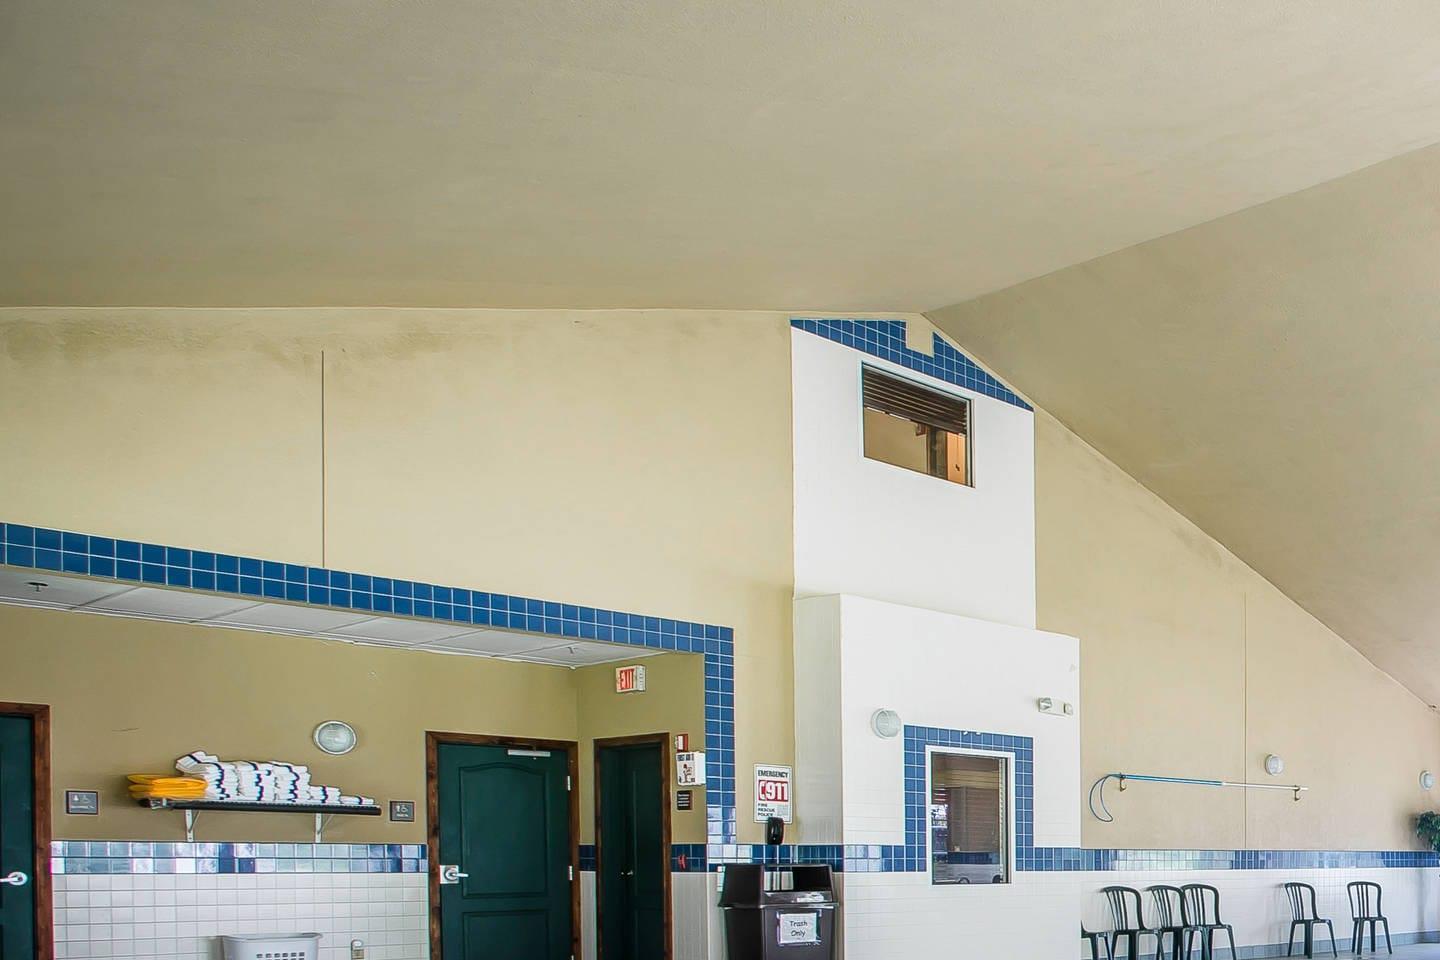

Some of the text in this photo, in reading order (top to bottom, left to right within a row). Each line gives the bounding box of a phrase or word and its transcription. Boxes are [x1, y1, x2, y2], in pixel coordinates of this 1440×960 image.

[620, 669, 635, 690] EXIT
[758, 770, 788, 778] EMERGENCY
[766, 781, 788, 800] 911
